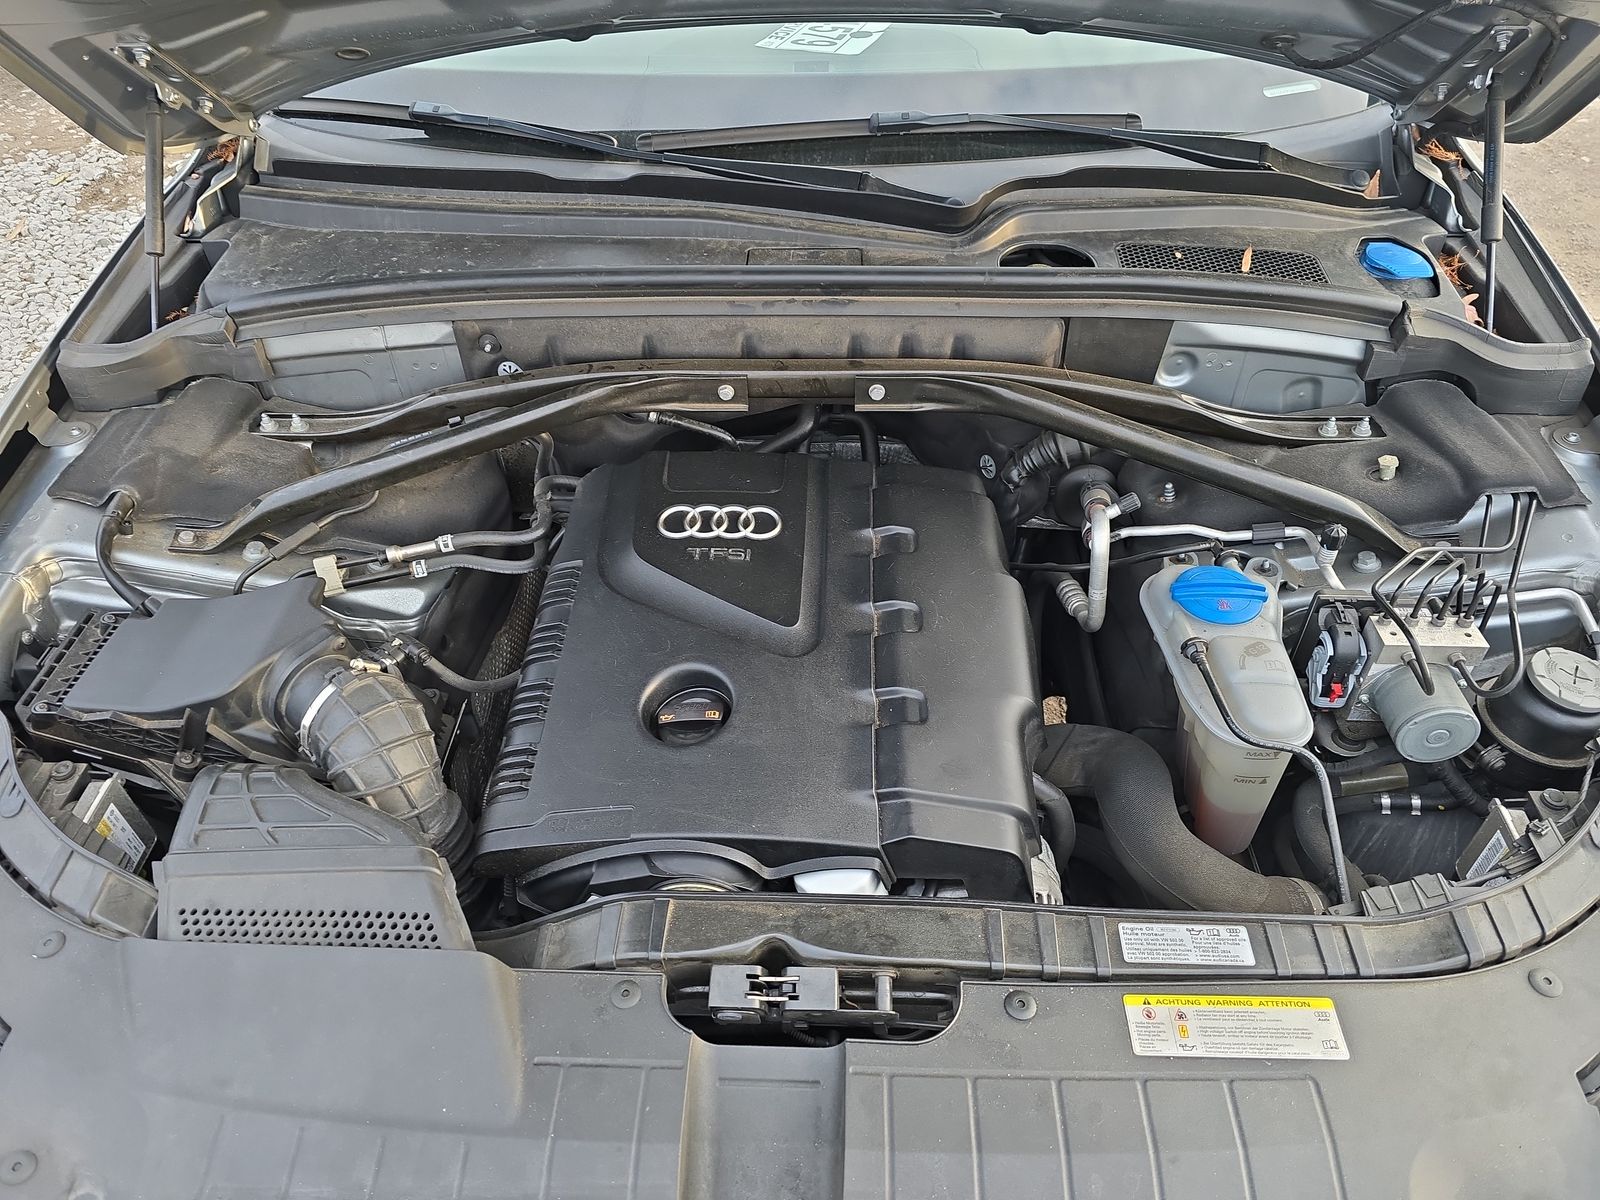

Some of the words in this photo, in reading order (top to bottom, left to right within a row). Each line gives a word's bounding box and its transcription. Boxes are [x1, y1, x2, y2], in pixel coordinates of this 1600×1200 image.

[686, 547, 751, 561] TFSI
[1155, 998, 1201, 1006] ACHTUNG
[1206, 999, 1253, 1007] WARNING
[1258, 1000, 1311, 1008] ATTENTION
